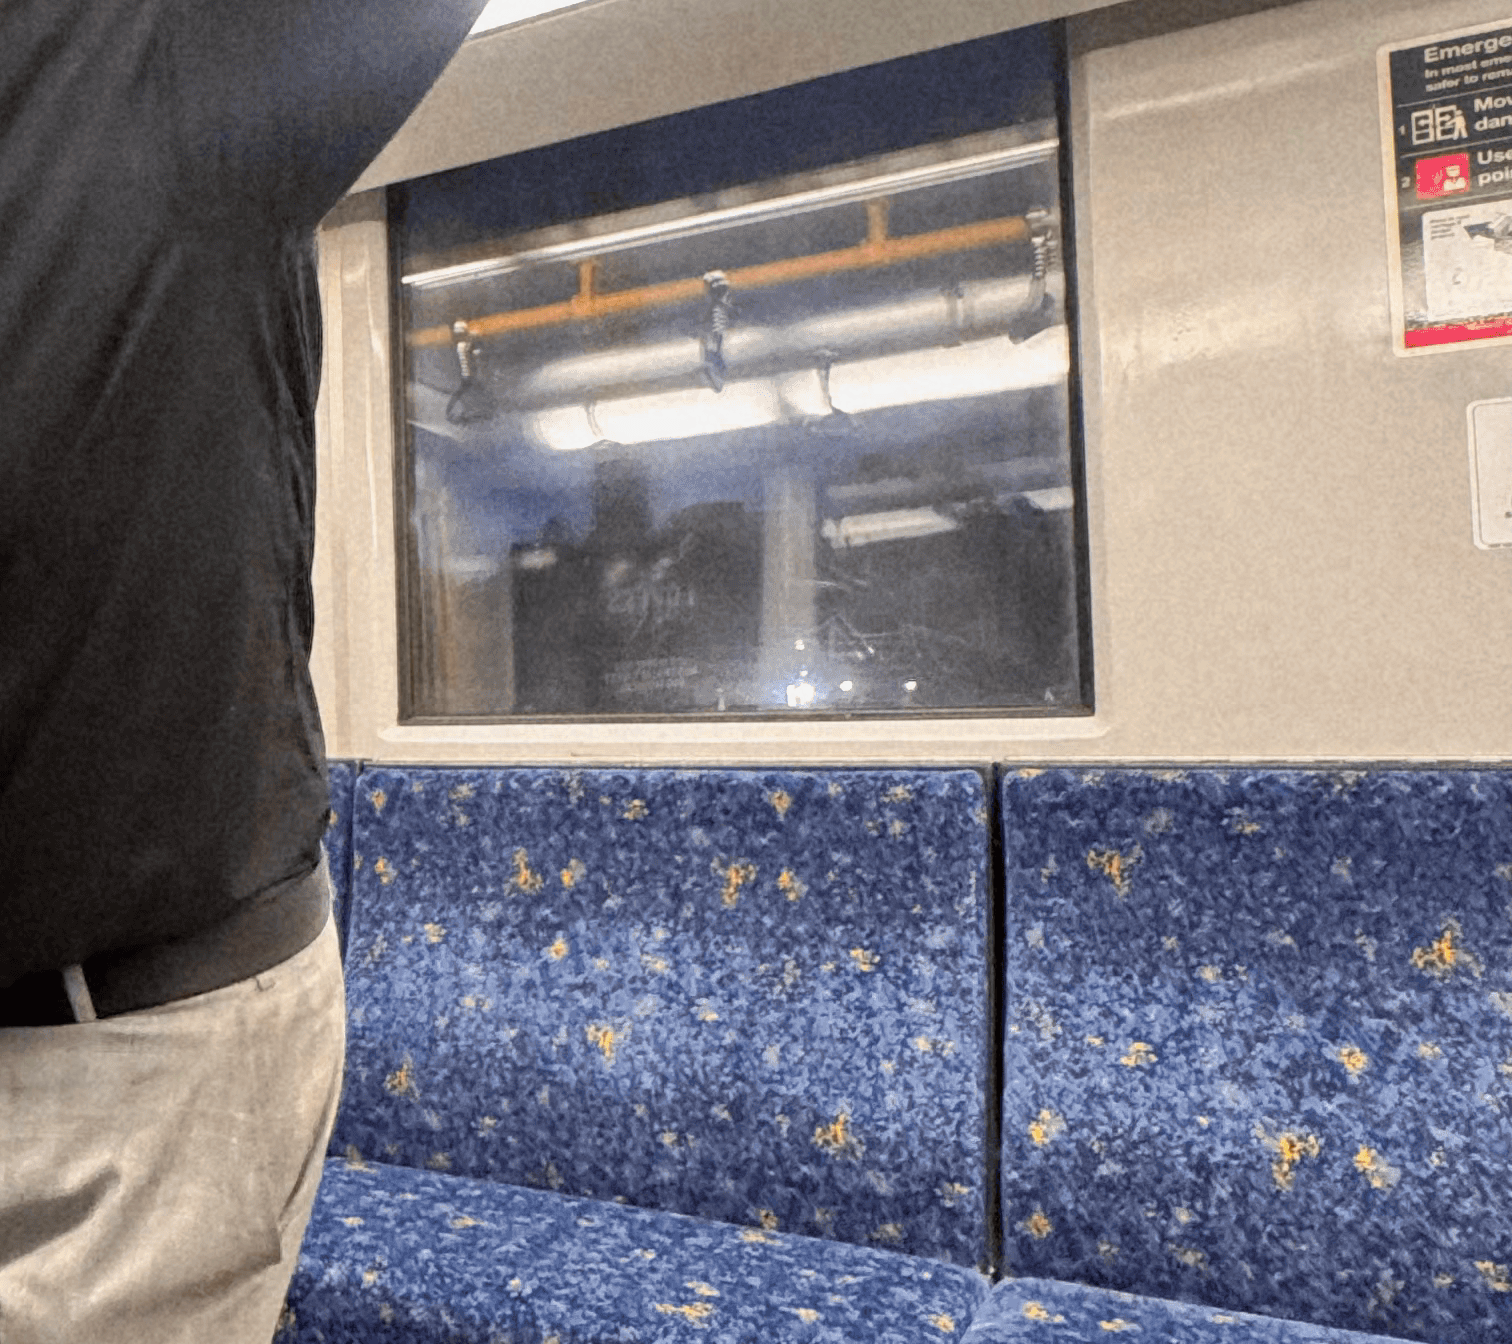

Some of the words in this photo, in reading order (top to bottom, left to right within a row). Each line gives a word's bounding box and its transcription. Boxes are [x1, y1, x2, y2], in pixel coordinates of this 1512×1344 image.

[1424, 35, 1512, 64] Emerge
[1425, 69, 1439, 79] In
[1441, 60, 1477, 76] most
[1426, 78, 1461, 92] safer
[1464, 74, 1479, 84] to
